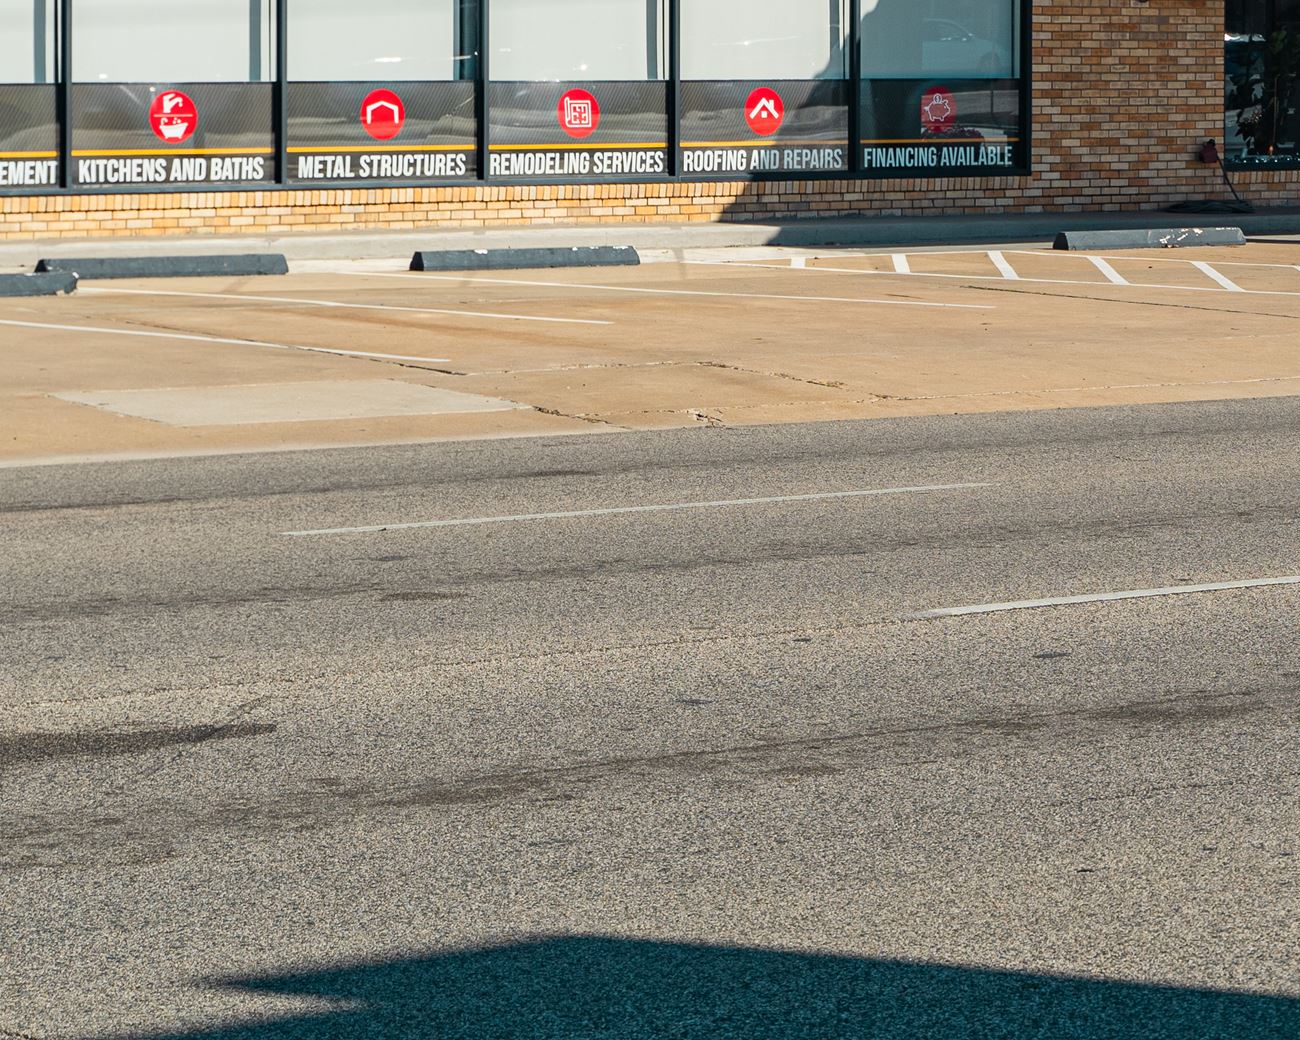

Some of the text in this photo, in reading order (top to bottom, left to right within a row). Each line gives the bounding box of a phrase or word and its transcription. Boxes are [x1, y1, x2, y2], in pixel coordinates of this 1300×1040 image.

[298, 153, 467, 179] METAL STRUCTURES
[489, 151, 664, 176] REMODELING SERVICES
[683, 148, 843, 172] ROOFING AND REPAIRS
[864, 146, 1013, 168] FINANCING AVAILABLE
[0, 160, 58, 185] EMENT
[78, 157, 265, 183] KITCHENS AND BATHS
